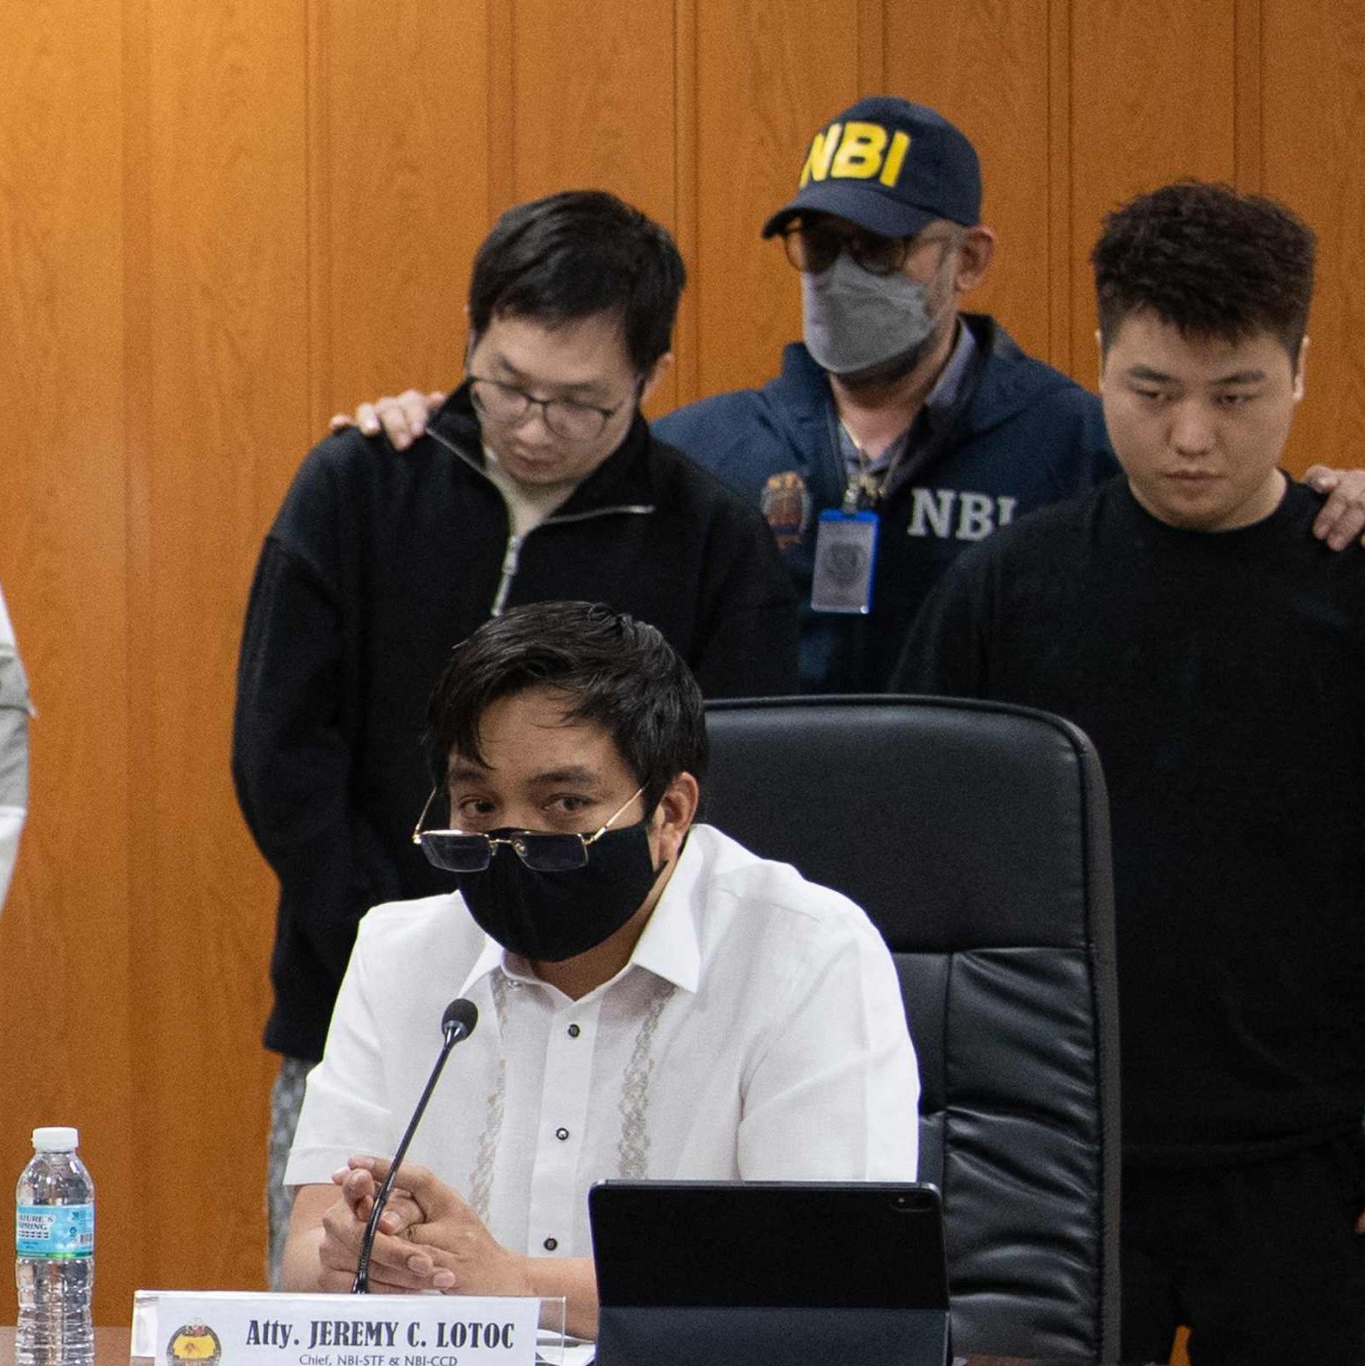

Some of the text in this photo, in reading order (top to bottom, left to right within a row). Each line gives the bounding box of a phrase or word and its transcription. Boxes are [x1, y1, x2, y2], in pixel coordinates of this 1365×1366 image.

[799, 121, 911, 188] NBI
[246, 1320, 515, 1349] Atty. JEREMY C. LOTOC
[337, 1355, 384, 1366] NBI-STF
[388, 1357, 400, 1366] &
